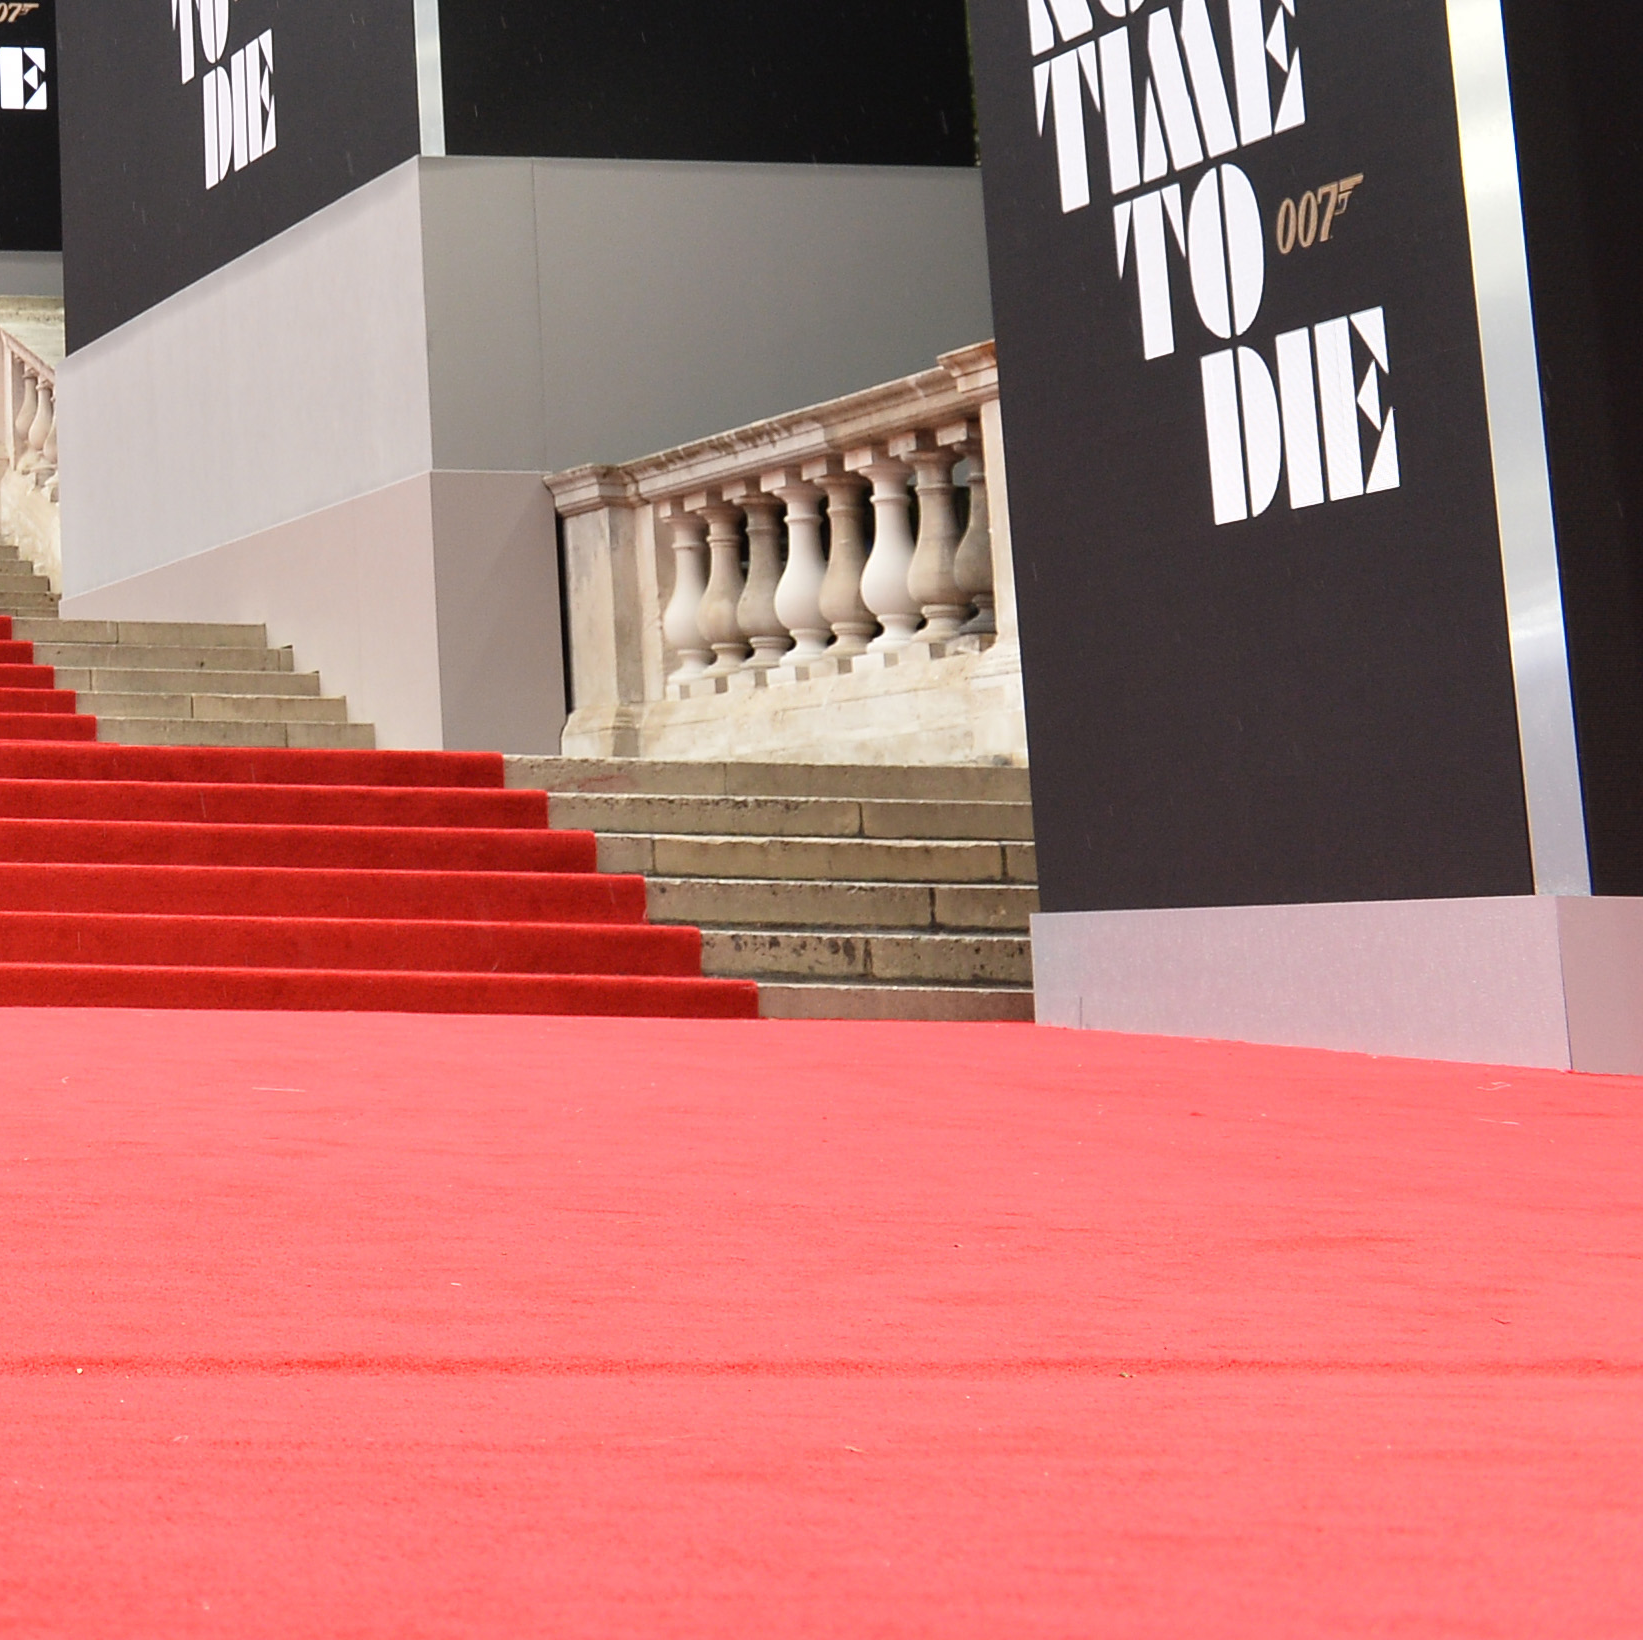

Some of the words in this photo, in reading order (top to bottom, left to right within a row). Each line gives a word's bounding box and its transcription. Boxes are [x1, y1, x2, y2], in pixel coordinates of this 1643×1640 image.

[203, 29, 276, 189] DIE
[1114, 164, 1264, 360] TO
[1275, 173, 1364, 256] 007
[1201, 307, 1400, 525] DIE
